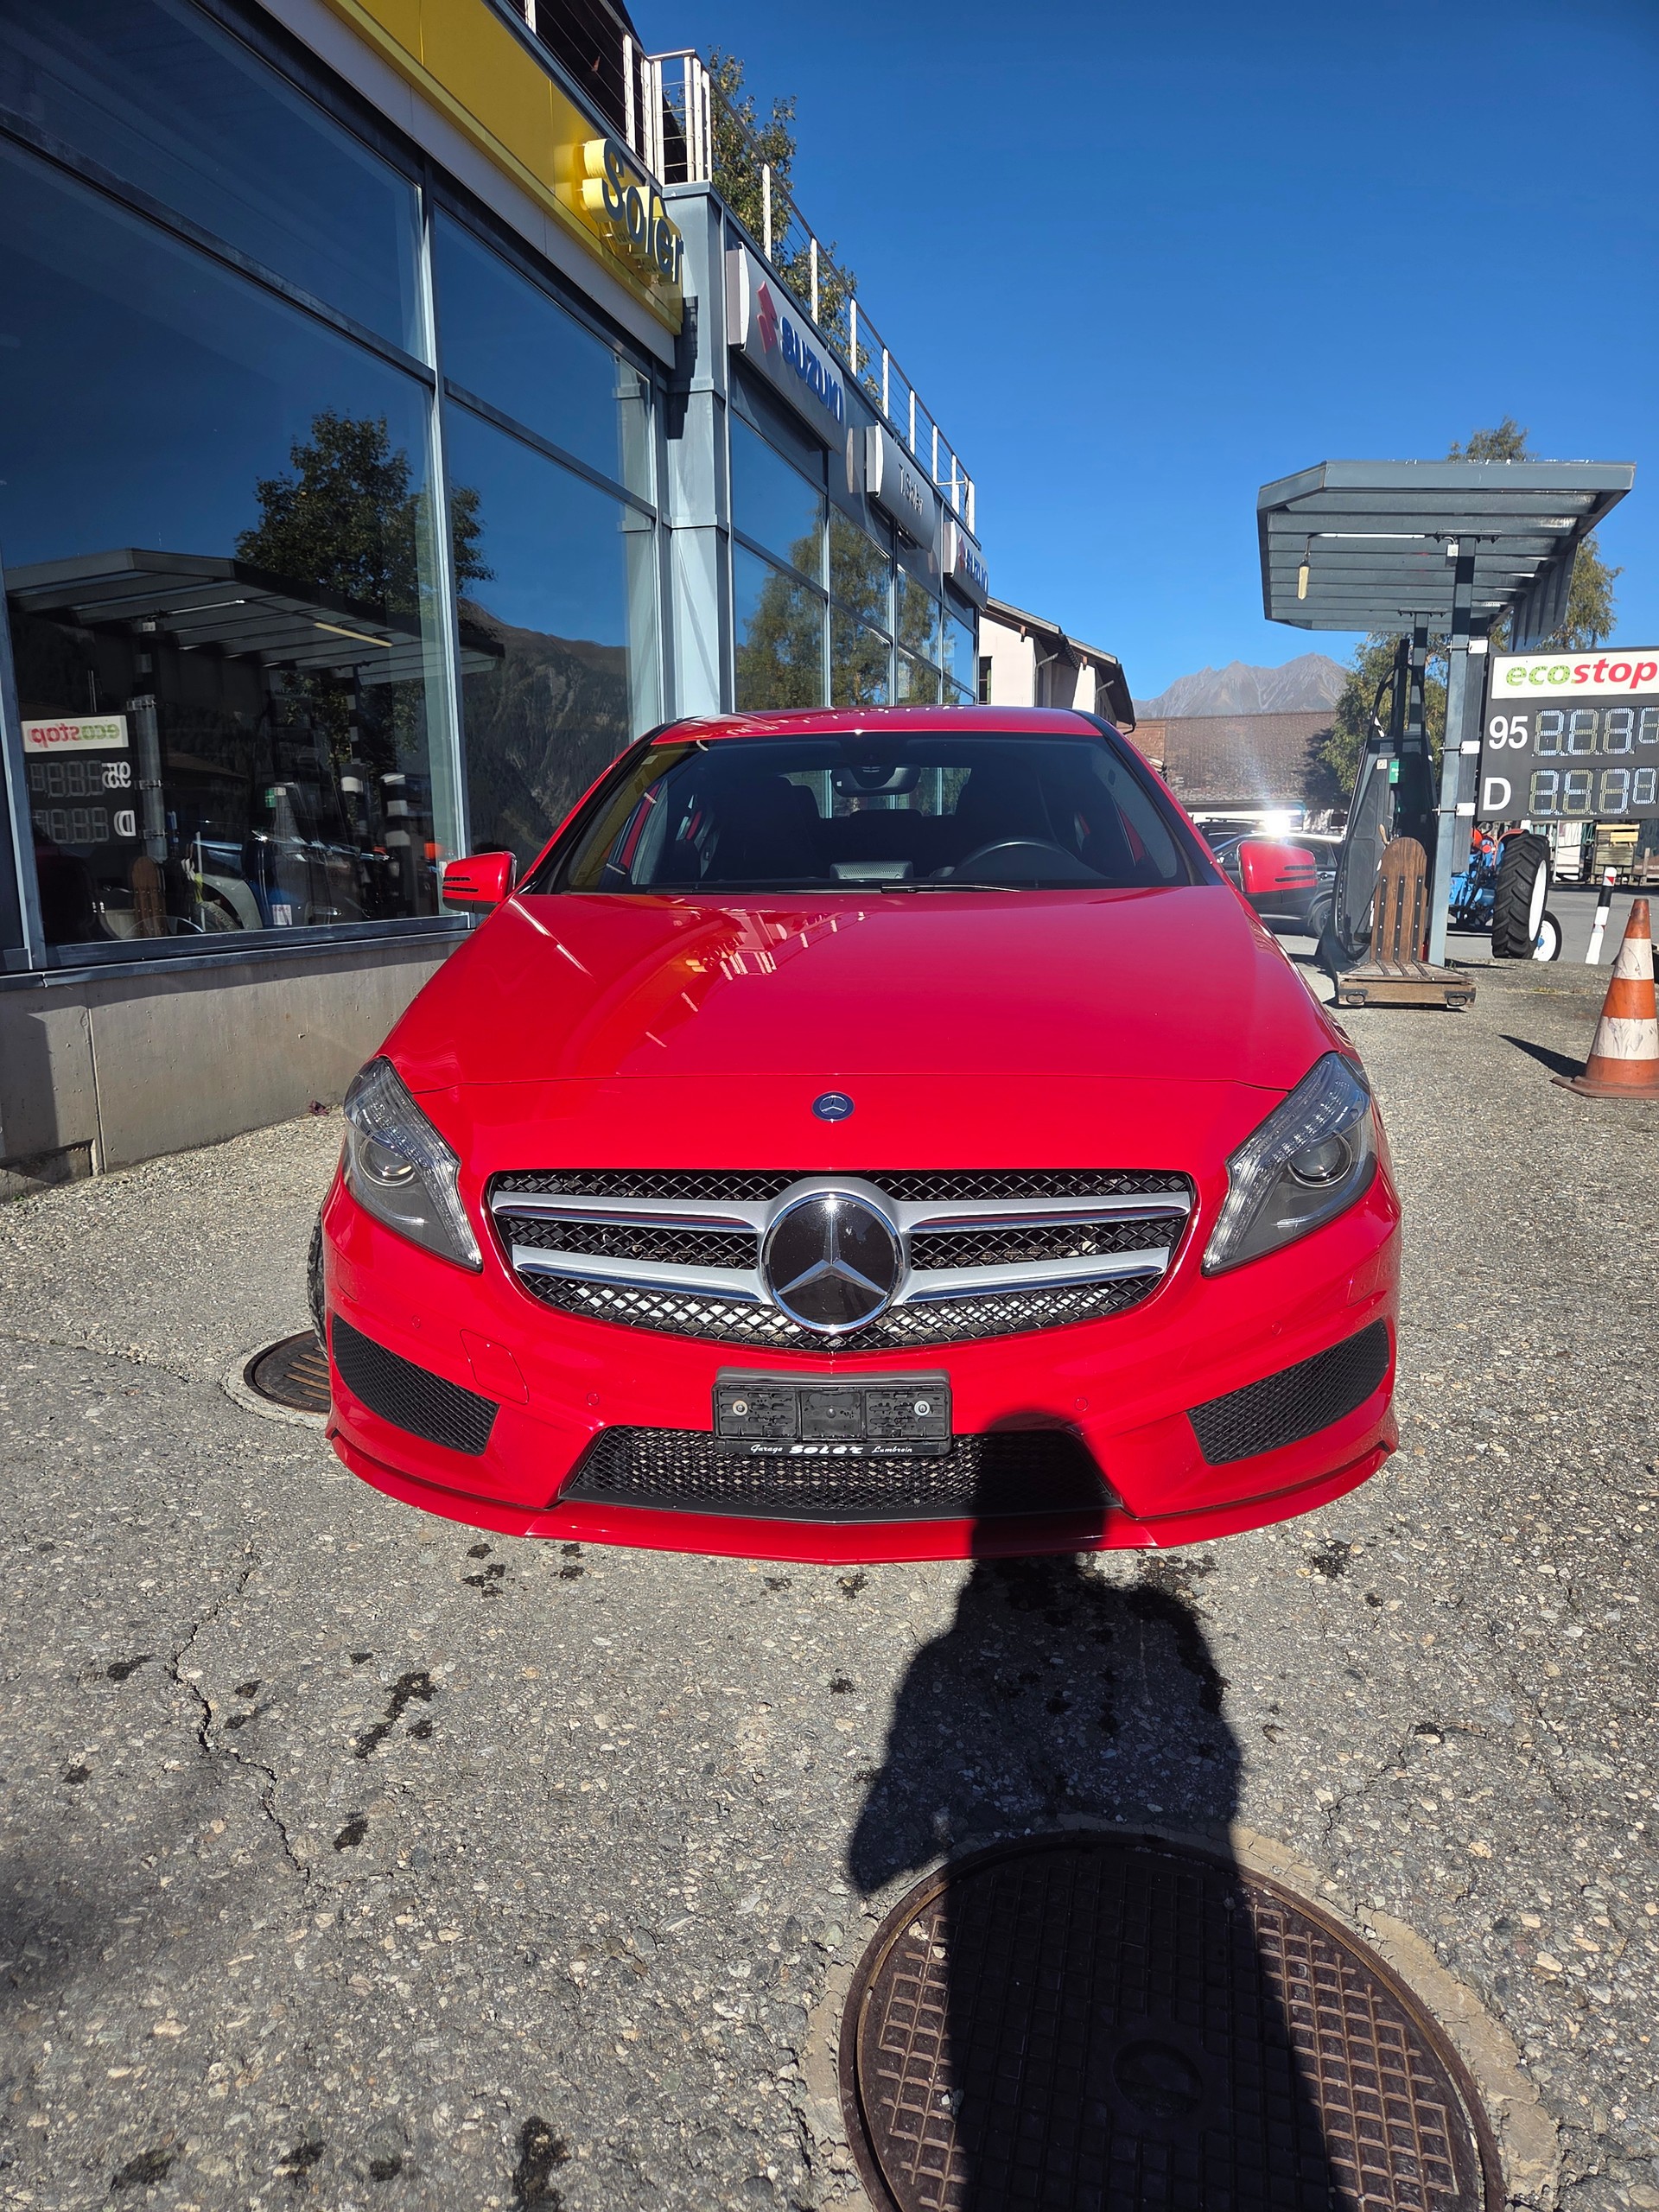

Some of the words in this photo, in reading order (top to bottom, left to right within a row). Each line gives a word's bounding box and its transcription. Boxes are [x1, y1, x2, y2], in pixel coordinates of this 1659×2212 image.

[780, 316, 842, 424] SUZUKI
[1506, 658, 1658, 690] ecostop
[1489, 715, 1529, 750] 95
[1483, 777, 1512, 810] D
[750, 1444, 783, 1454] Garage
